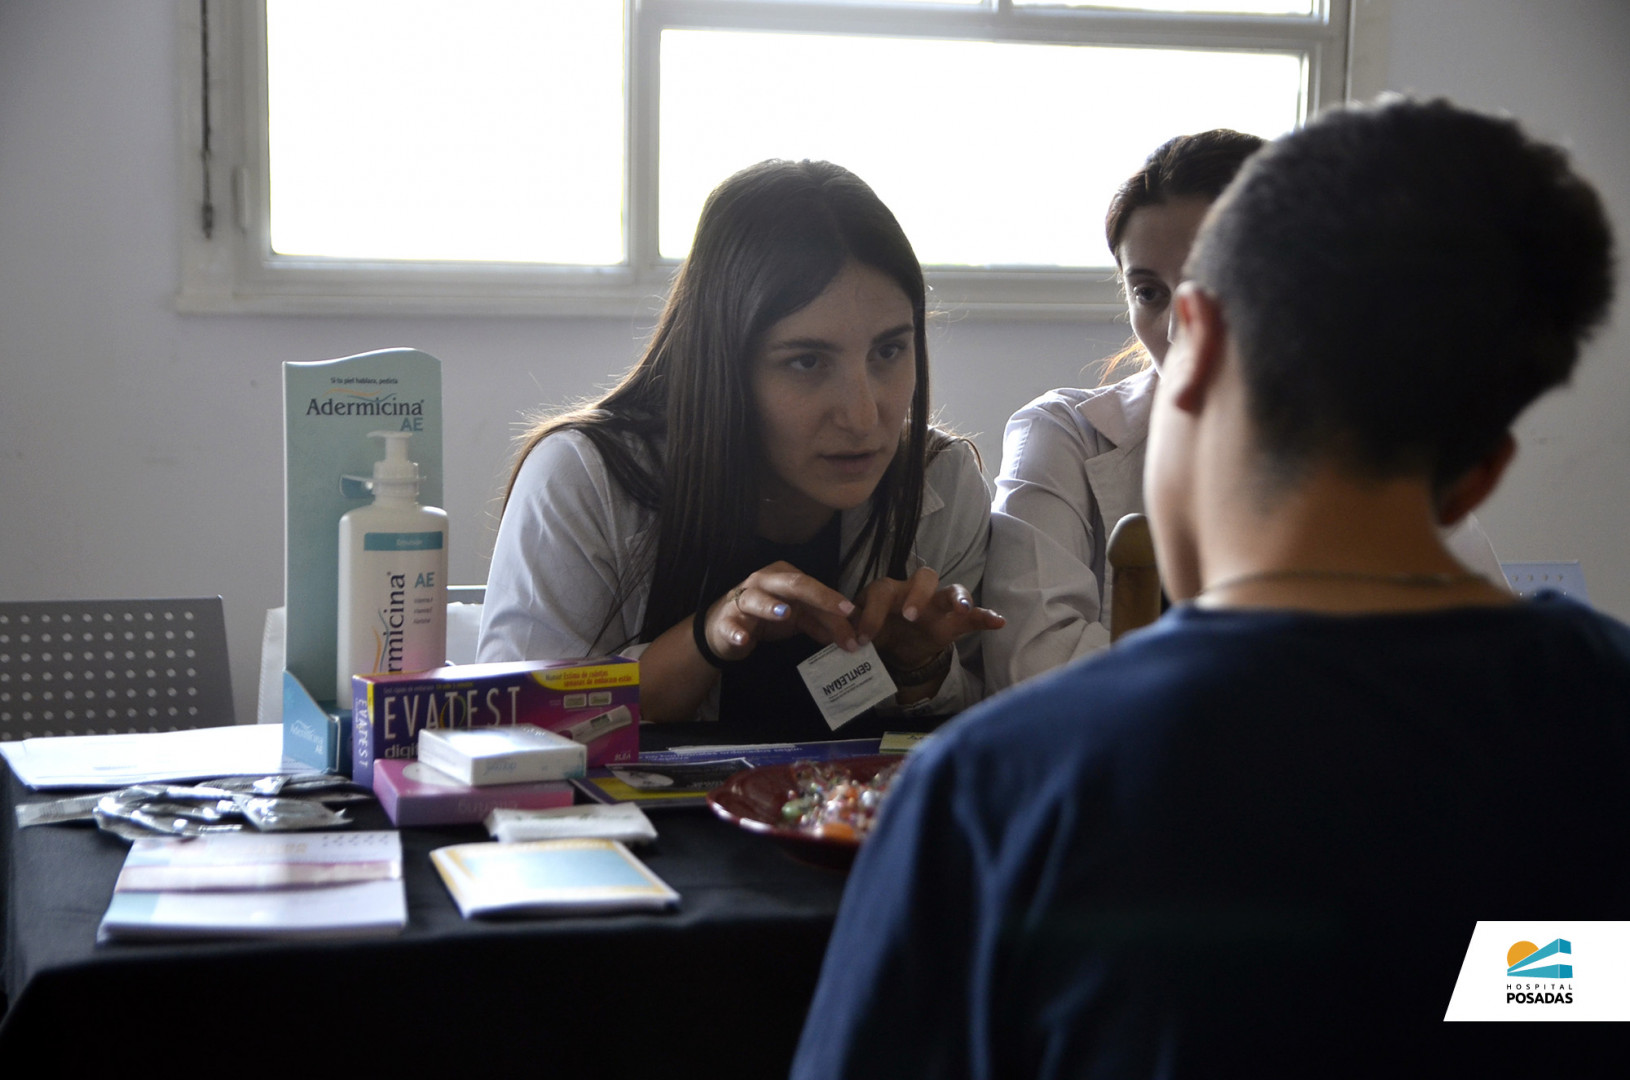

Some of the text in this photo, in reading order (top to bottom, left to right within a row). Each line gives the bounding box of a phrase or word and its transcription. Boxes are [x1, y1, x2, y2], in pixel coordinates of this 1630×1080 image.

[306, 397, 423, 416] Adermicina
[401, 417, 423, 431] AE
[415, 572, 435, 588] AE
[384, 686, 520, 739] EVATEST
[358, 699, 368, 768] EVATEST
